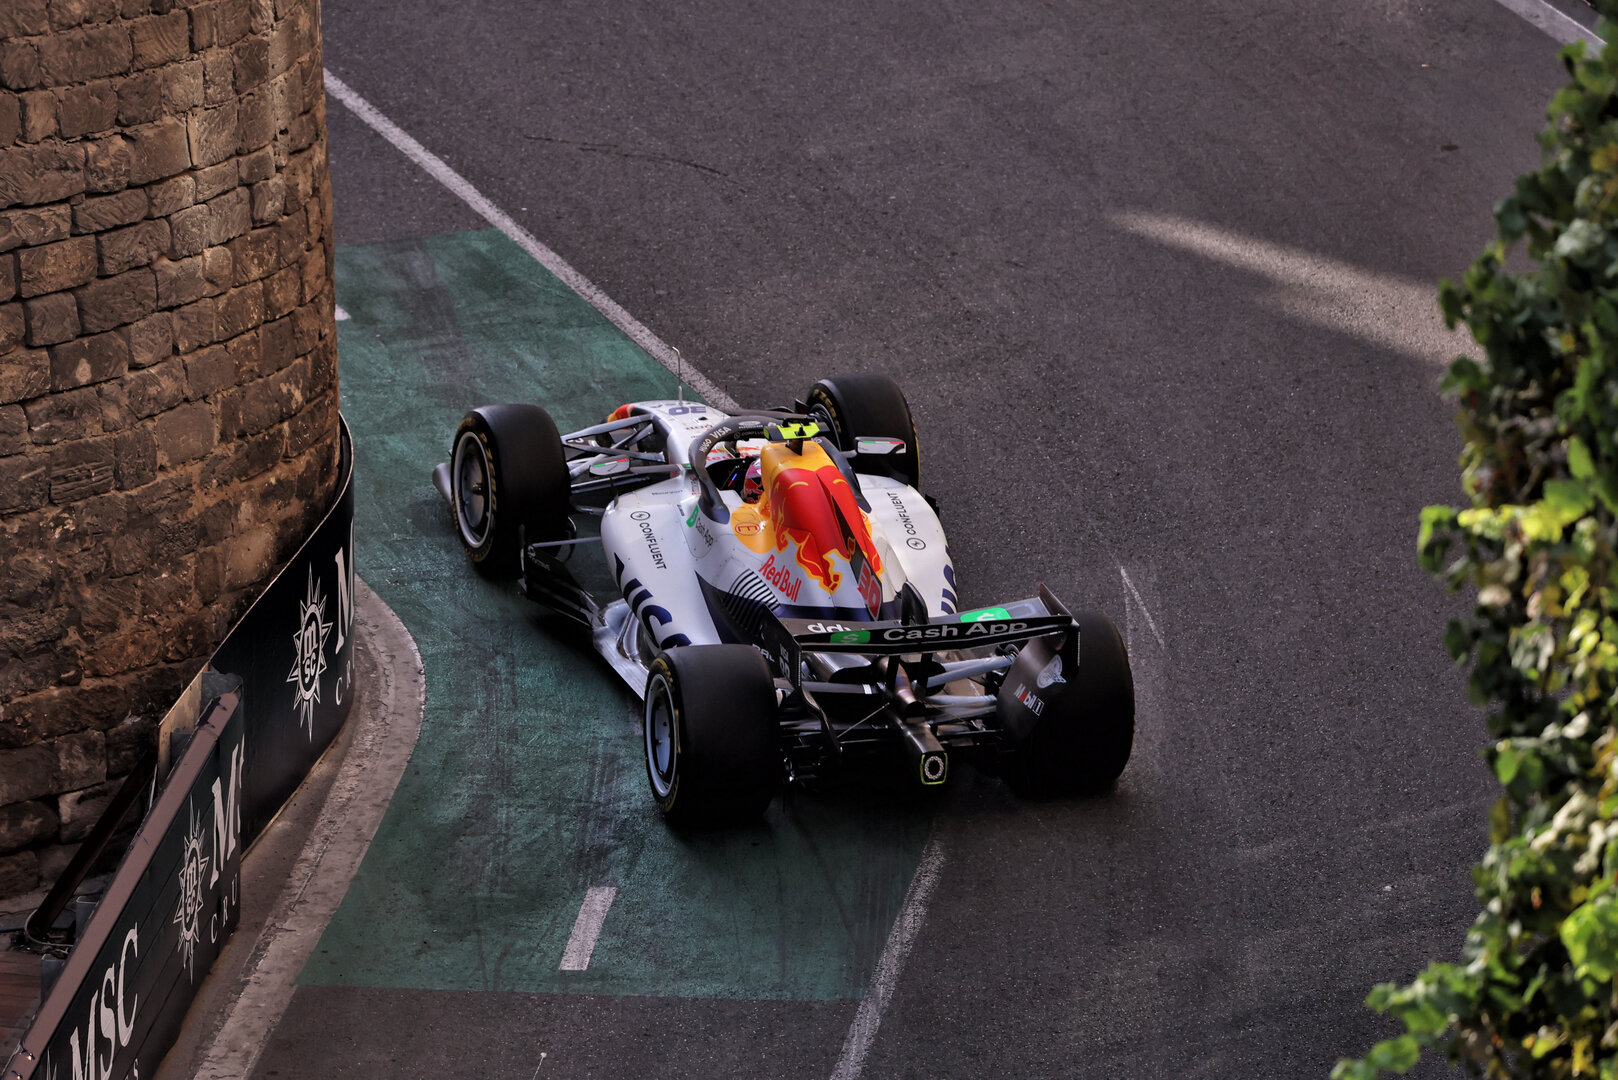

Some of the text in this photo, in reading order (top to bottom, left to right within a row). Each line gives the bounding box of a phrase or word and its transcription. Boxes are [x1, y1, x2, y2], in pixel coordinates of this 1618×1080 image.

[709, 426, 732, 439] VISA
[887, 492, 917, 536] CONFLUENT
[639, 522, 667, 570] CONFLUENT
[857, 560, 881, 619] 30
[883, 622, 1028, 641] Cash App
